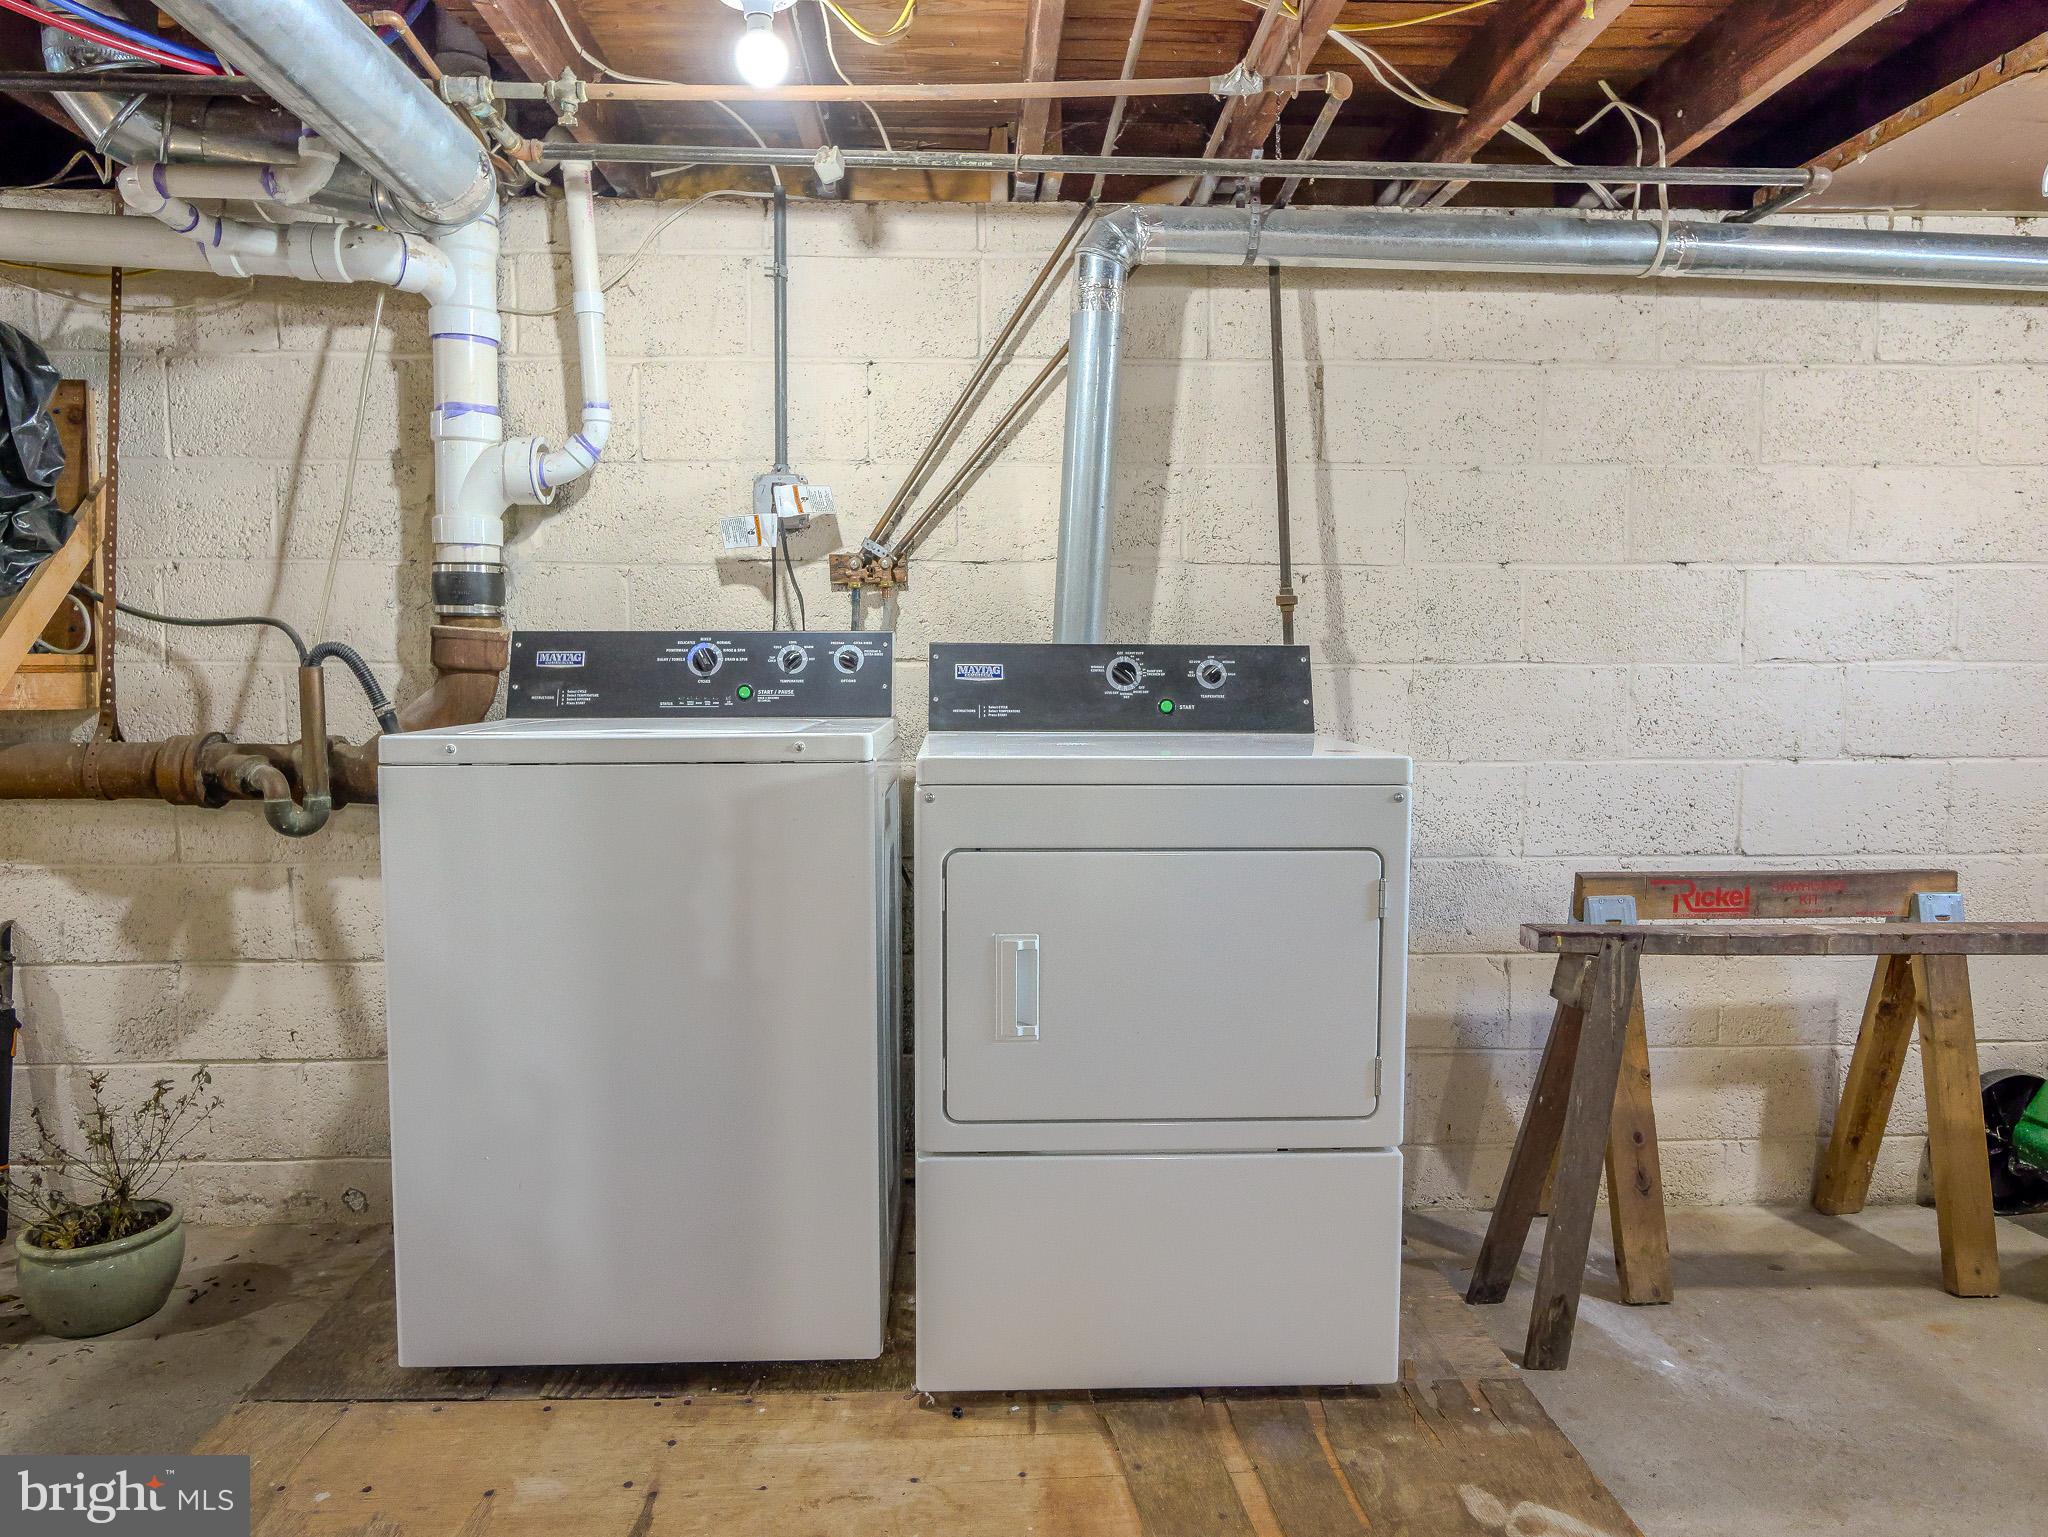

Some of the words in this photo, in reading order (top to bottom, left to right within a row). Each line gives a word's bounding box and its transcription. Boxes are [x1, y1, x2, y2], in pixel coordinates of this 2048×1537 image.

[539, 653, 582, 662] MAYTAG
[957, 666, 1001, 674] MAYTAG
[1650, 880, 1751, 913] Rickel
